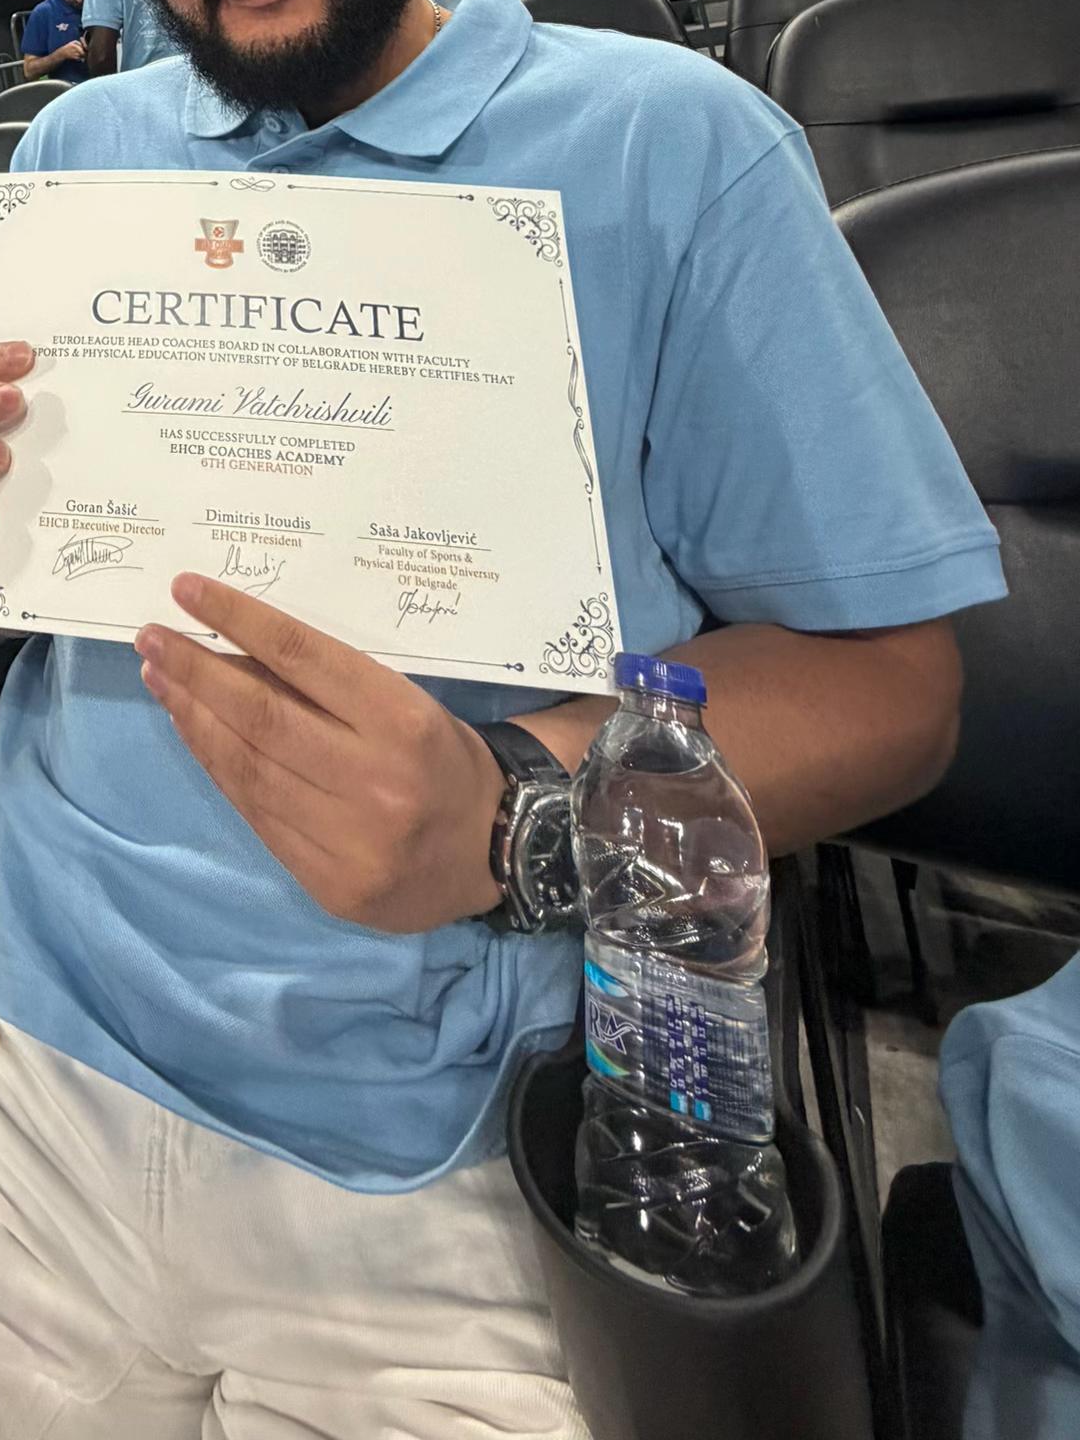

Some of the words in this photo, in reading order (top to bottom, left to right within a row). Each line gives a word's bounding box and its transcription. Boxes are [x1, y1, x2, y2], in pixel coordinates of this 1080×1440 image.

[92, 290, 424, 342] CERTIFICATE
[53, 336, 126, 346] EUROLEAGUE
[128, 337, 159, 347] HEAD
[162, 338, 215, 349] COACHES
[219, 341, 259, 352] BOARD
[262, 343, 275, 353] IN
[278, 344, 379, 361] COLLABORATION
[383, 352, 414, 364] WITH
[417, 355, 471, 368] FACULTY
[32, 347, 69, 357] SPORTS
[72, 348, 80, 357] &
[82, 348, 135, 359] PHYSICAL
[138, 350, 206, 362] EDUCATION
[209, 352, 280, 366] UNIVERSITY
[283, 357, 299, 367] OF
[302, 359, 366, 373] BELGRADE
[369, 364, 417, 377] HEREBY
[420, 367, 480, 382] CERTIFIES
[482, 373, 515, 385] THAT
[128, 382, 226, 413] Gurami
[232, 386, 394, 427] Vatchrishvili
[160, 428, 183, 439] HAS
[186, 431, 277, 446] SUCCESSFULLY
[280, 436, 355, 452] COMPLETED
[170, 444, 205, 456] EHCB
[208, 446, 271, 460] COACHES
[276, 451, 345, 466] ACADEMY
[201, 457, 225, 470] 6TH
[229, 459, 313, 476] GENERATION
[66, 499, 103, 514] Goran
[106, 499, 138, 517] Šašić
[39, 516, 69, 529] EHCB
[72, 518, 120, 533] Executive
[123, 521, 165, 536] Director
[206, 509, 260, 526] Dimitris
[265, 513, 312, 530] Itoudis
[211, 529, 247, 542] EHCB
[251, 533, 302, 547] President
[369, 522, 400, 538] Saša
[403, 526, 478, 546] Jakovljević
[378, 544, 414, 558] Faculty
[417, 549, 428, 559] of
[430, 550, 462, 563] Sports
[464, 553, 473, 563] &
[353, 556, 394, 570] Physical
[397, 560, 447, 575] Education
[449, 565, 500, 582] University
[398, 574, 410, 586] Of
[415, 576, 458, 591] Belgrade
